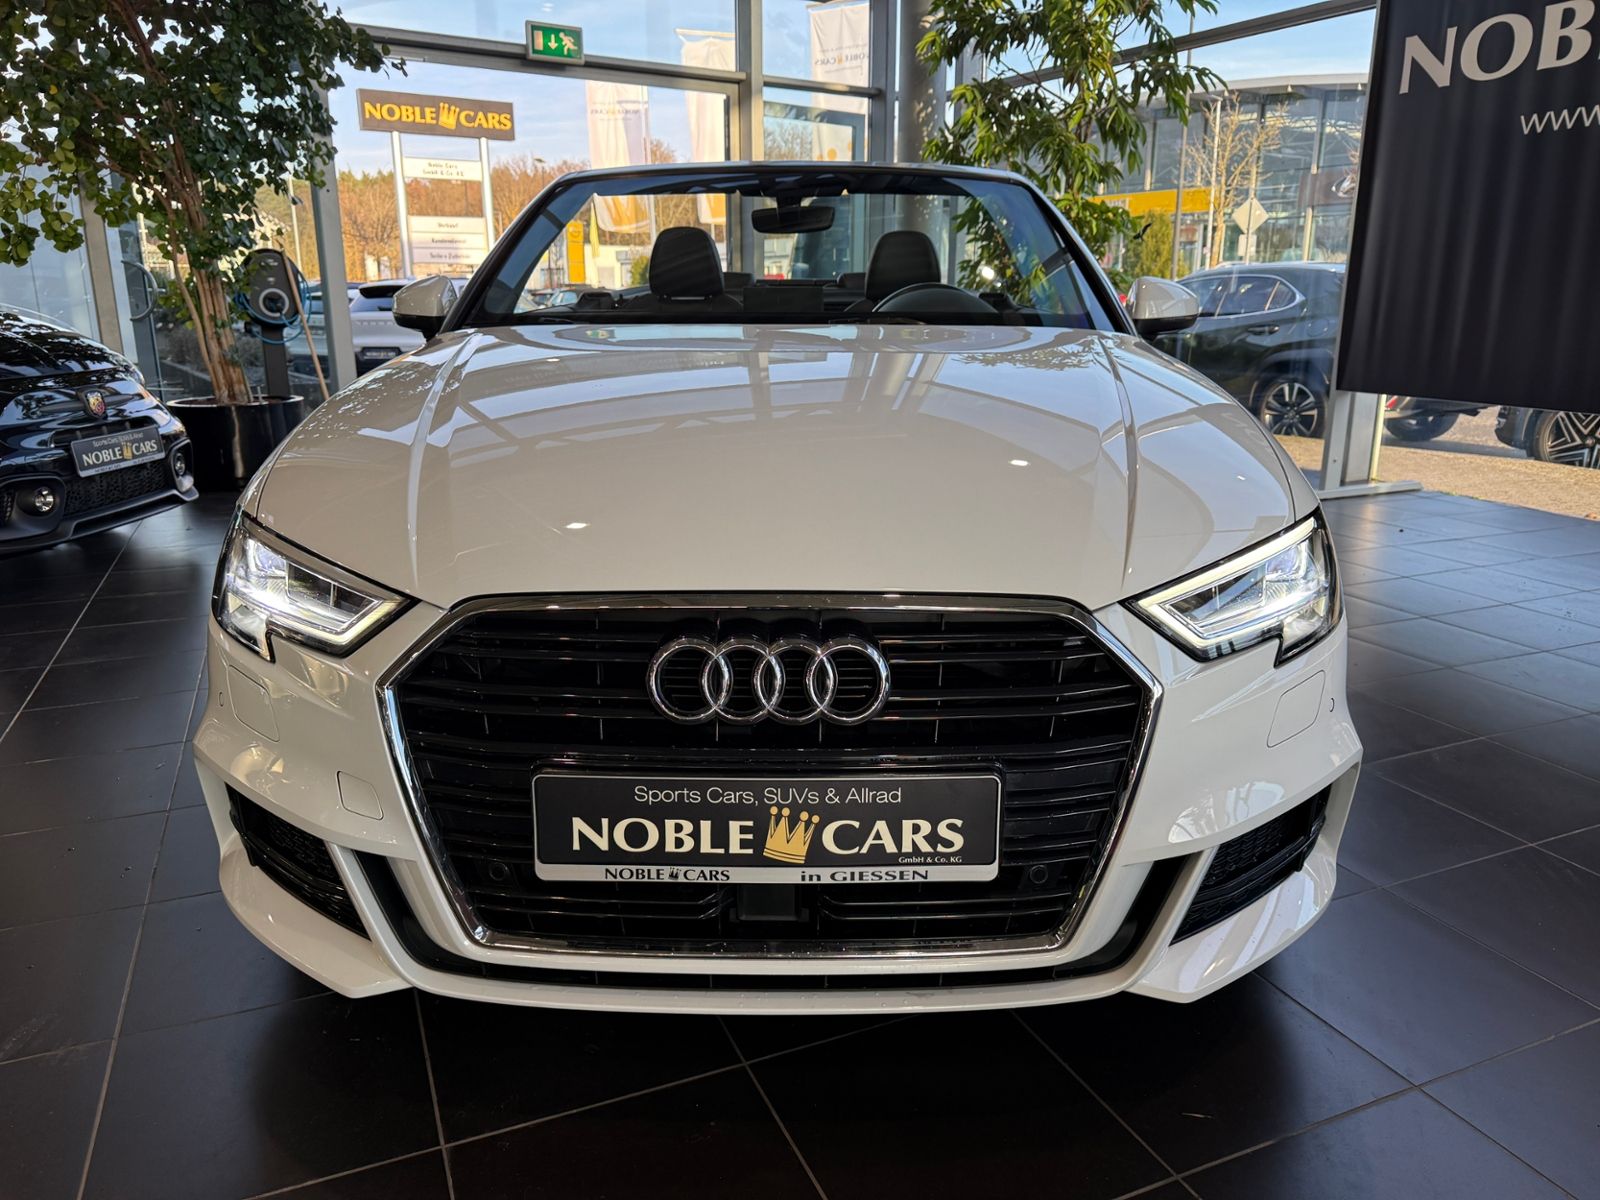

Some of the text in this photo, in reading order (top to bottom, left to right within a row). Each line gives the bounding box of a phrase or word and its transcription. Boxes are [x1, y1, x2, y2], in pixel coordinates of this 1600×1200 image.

[1399, 0, 1600, 94] NOB
[363, 102, 512, 130] NOBLE CARS
[82, 447, 123, 467] NOBLE
[132, 440, 158, 455] CARS
[634, 785, 901, 806] Sports Cars, SUVs & Allrad
[571, 816, 965, 855] NOBLE CARS
[898, 855, 963, 864] GmbH & Co. KG
[604, 867, 929, 882] NOBLE CARS in GIESSEN
